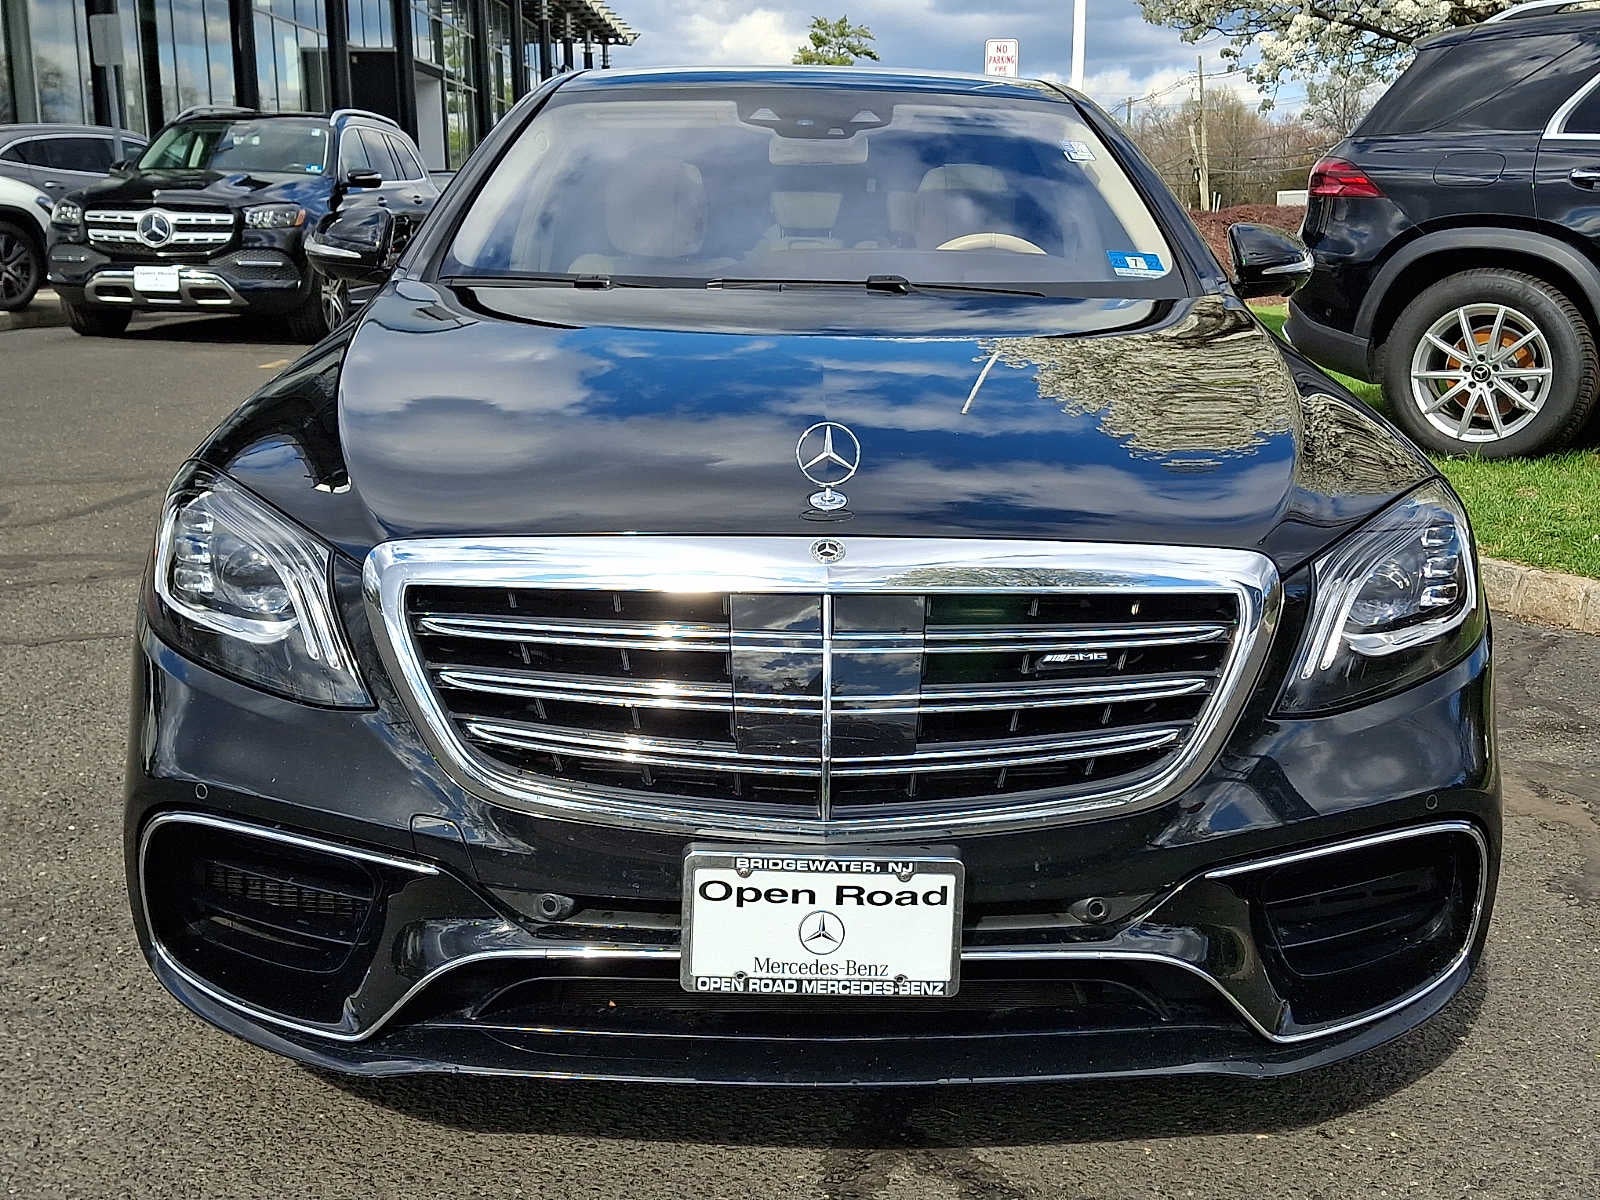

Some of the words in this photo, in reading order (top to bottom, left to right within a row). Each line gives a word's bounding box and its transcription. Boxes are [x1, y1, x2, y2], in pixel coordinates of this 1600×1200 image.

[996, 44, 1008, 54] NO
[988, 55, 1015, 65] PARKING
[736, 858, 881, 873] BRIDGEWATER,
[888, 863, 913, 873] NJ
[698, 880, 816, 908] Open
[835, 885, 948, 907] Road
[753, 957, 889, 977] Mercedes-Benz
[697, 977, 744, 992] OPEN
[748, 979, 798, 993] ROAD
[802, 980, 945, 996] MERCEDES-BENZ
